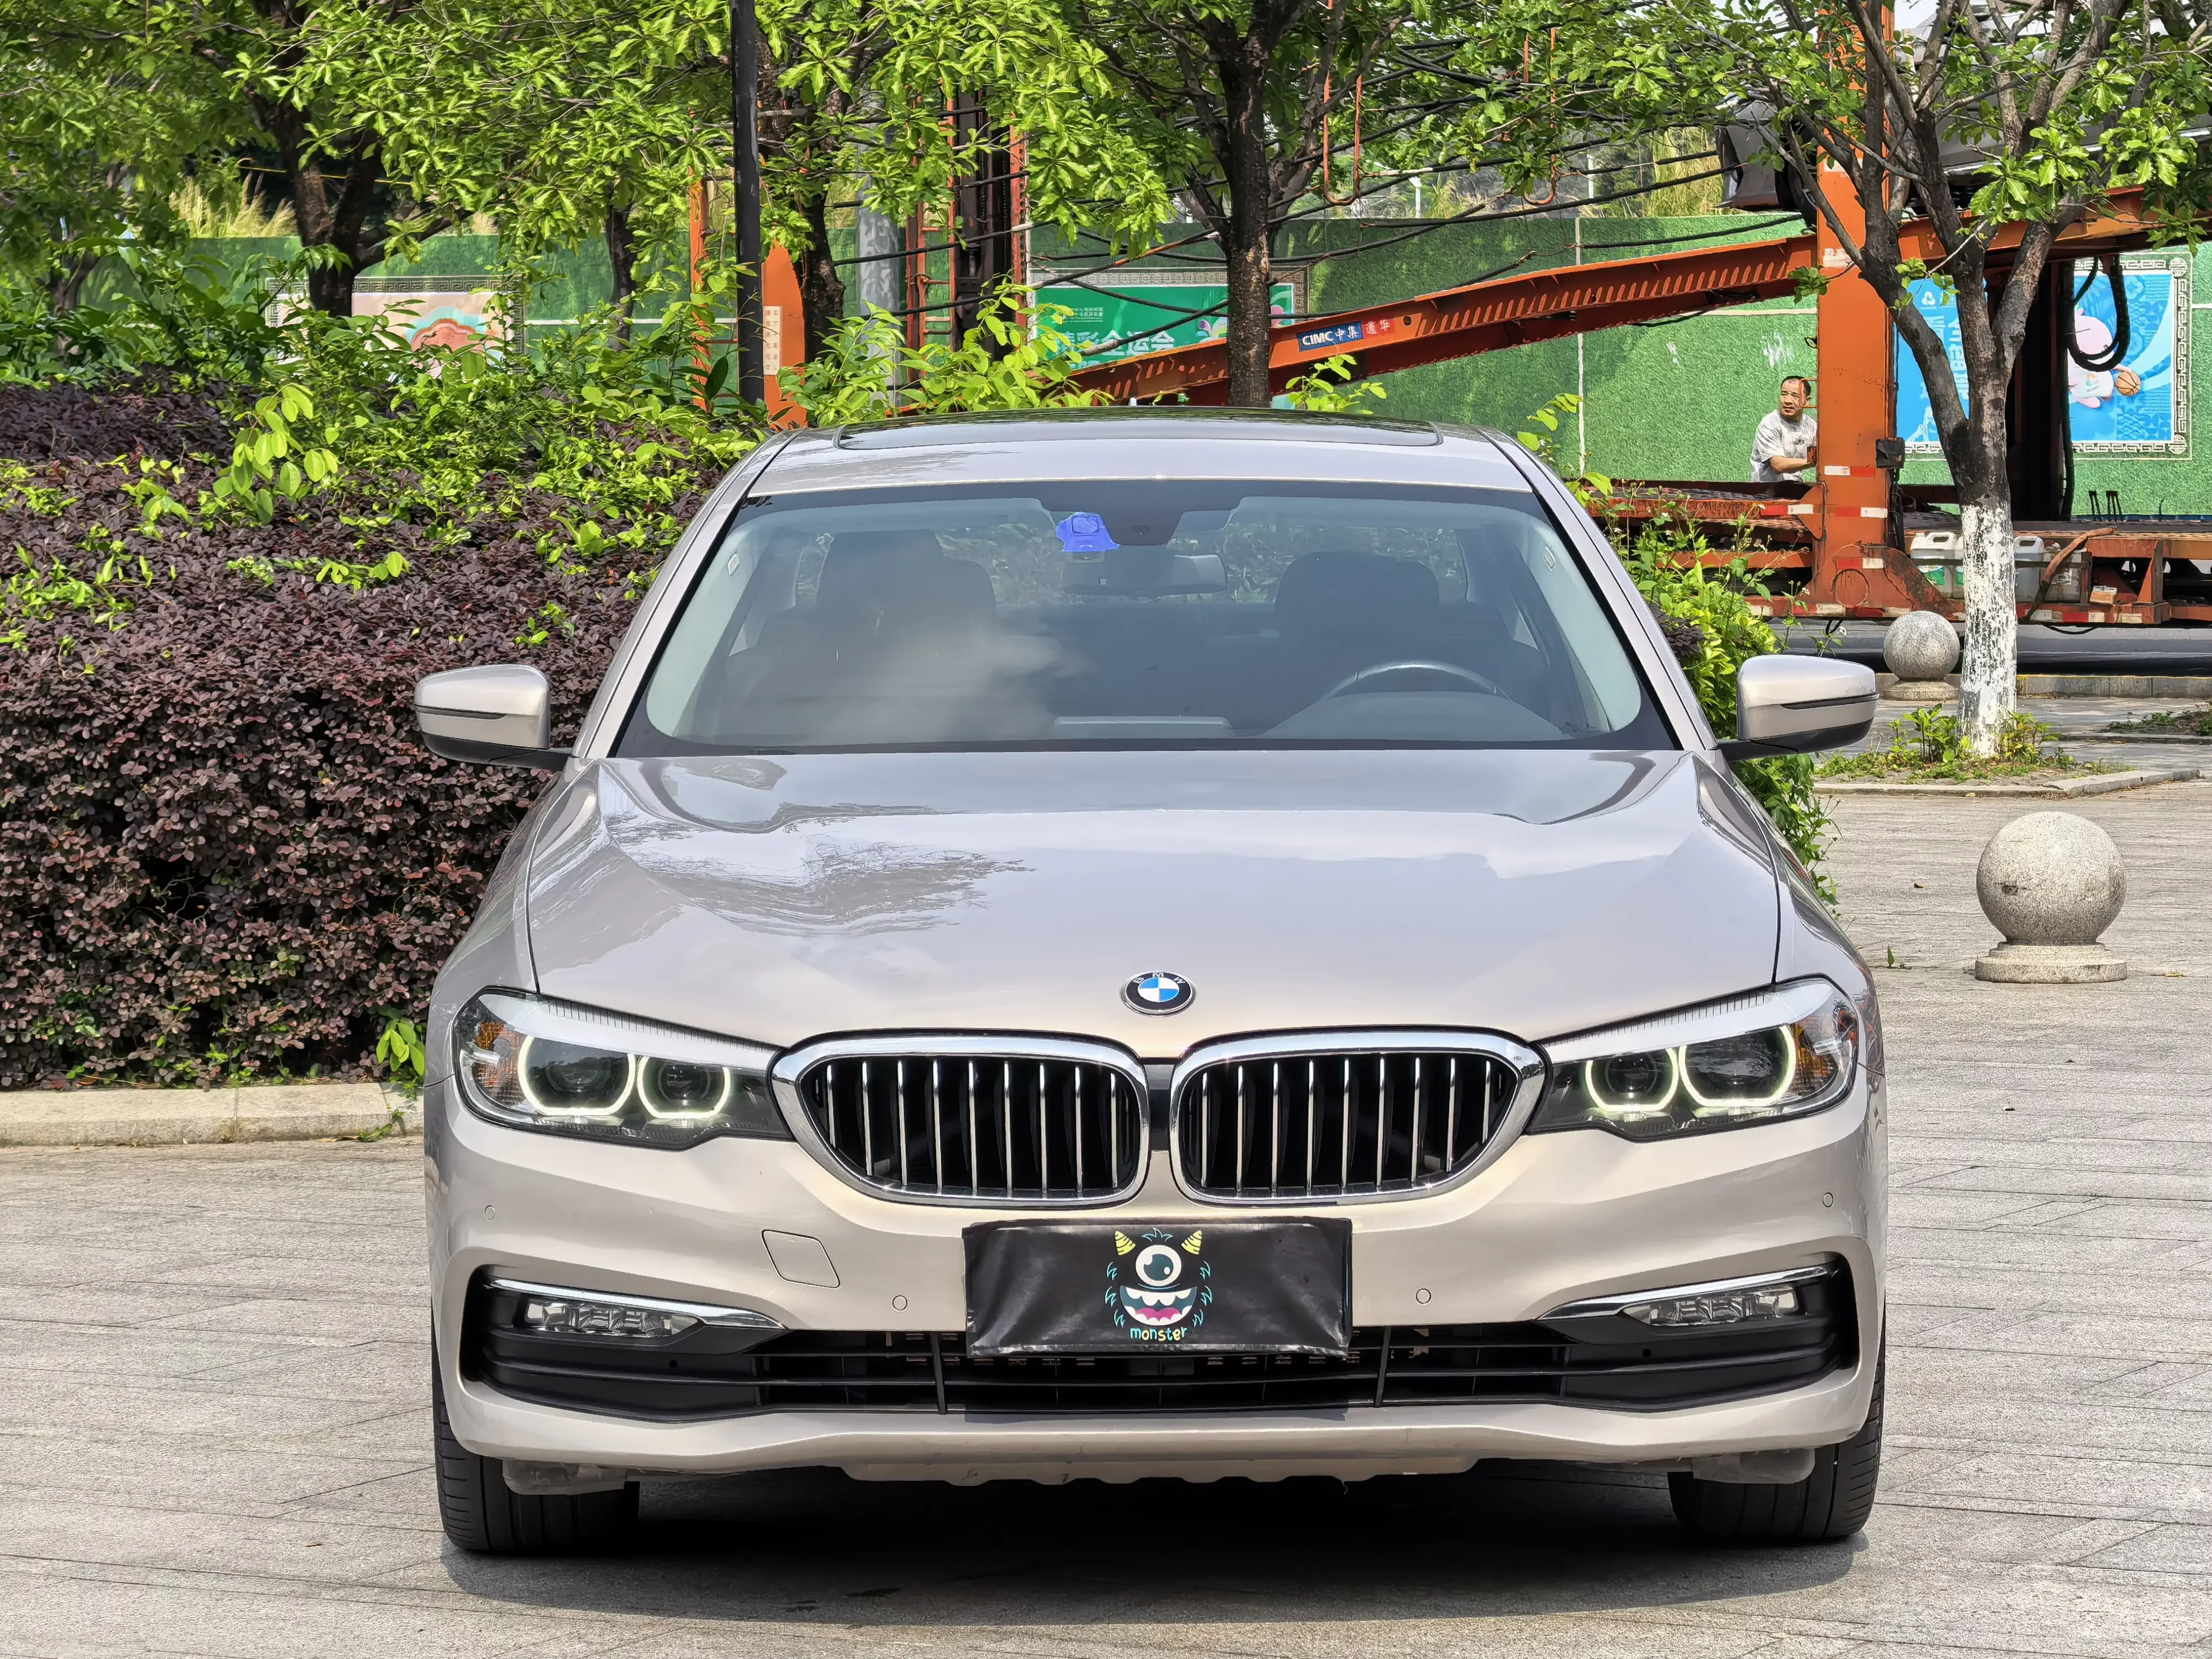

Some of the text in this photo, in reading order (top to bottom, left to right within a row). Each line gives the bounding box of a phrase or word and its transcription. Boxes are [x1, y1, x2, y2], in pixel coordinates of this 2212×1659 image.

[1302, 331, 1333, 346] CIMC
[1335, 326, 1359, 341] 中集
[1132, 973, 1186, 984] BMW
[1130, 1326, 1188, 1341] monster
